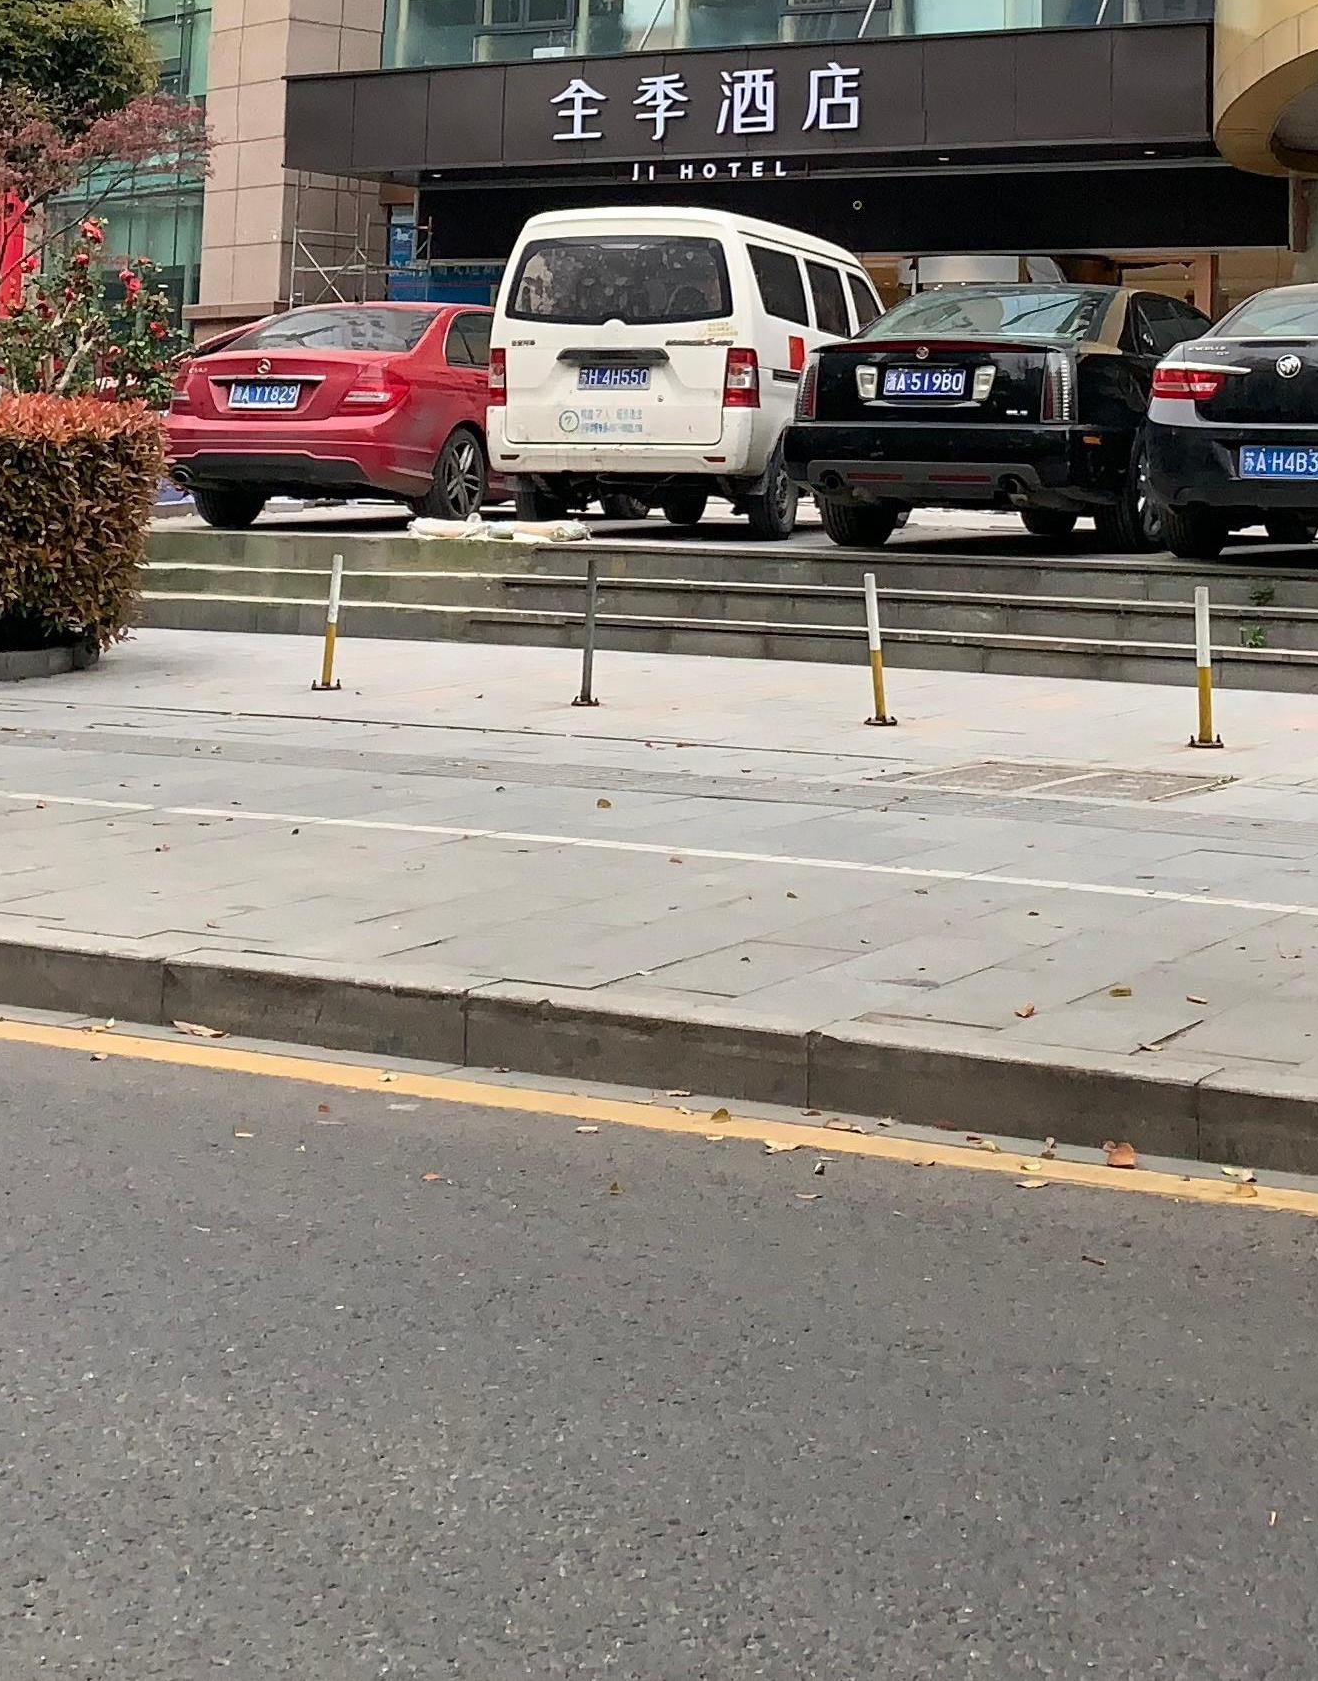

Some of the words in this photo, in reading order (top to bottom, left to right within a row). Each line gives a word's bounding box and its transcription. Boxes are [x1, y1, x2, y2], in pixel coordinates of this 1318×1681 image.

[550, 62, 862, 142] 全季酒店
[631, 163, 655, 182] JI
[679, 160, 788, 181] HOTEL
